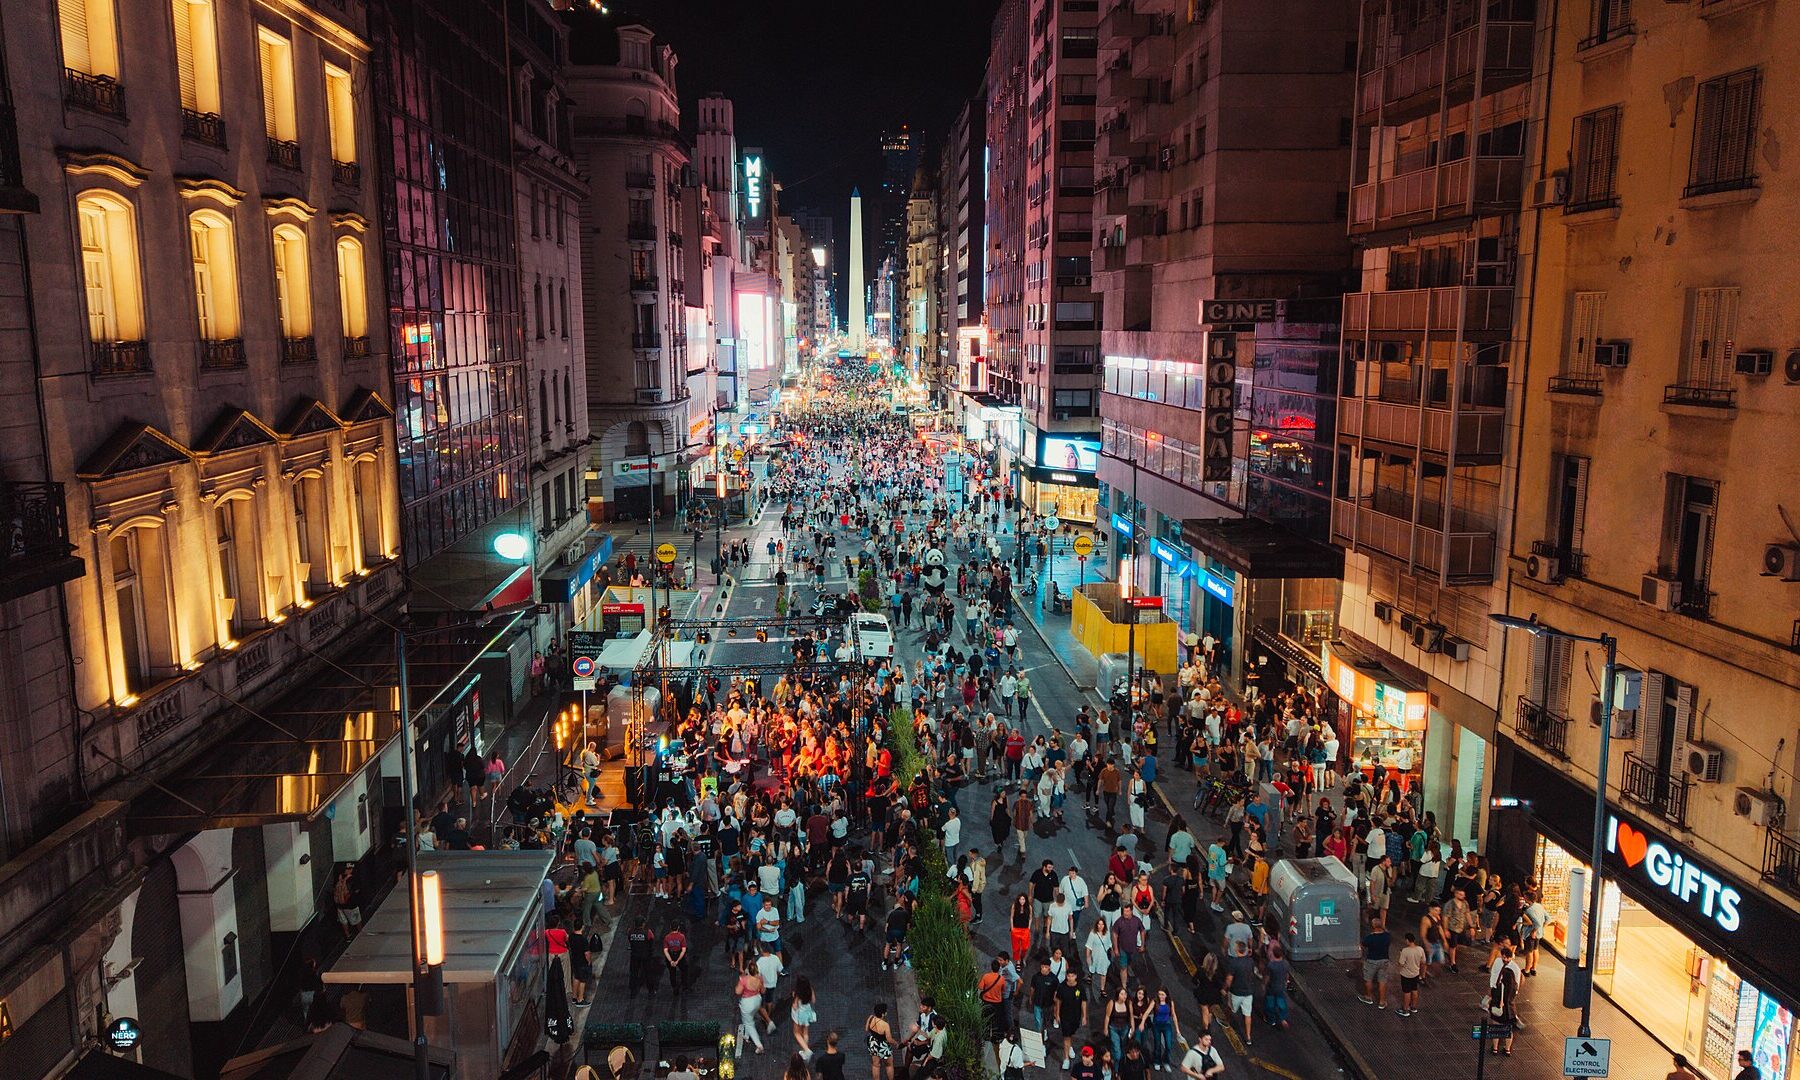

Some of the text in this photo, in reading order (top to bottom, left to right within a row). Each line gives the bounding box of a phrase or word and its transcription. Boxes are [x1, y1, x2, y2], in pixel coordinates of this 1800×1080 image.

[746, 156, 761, 217] MET
[1207, 303, 1272, 320] CINE
[1208, 337, 1234, 459] LORCA
[1606, 815, 1741, 932] I GiFTS
[1314, 916, 1329, 926] BA
[111, 1032, 136, 1040] NERO
[1572, 1060, 1600, 1068] CONTROL
[1565, 1067, 1607, 1075] ELECTRONICO
